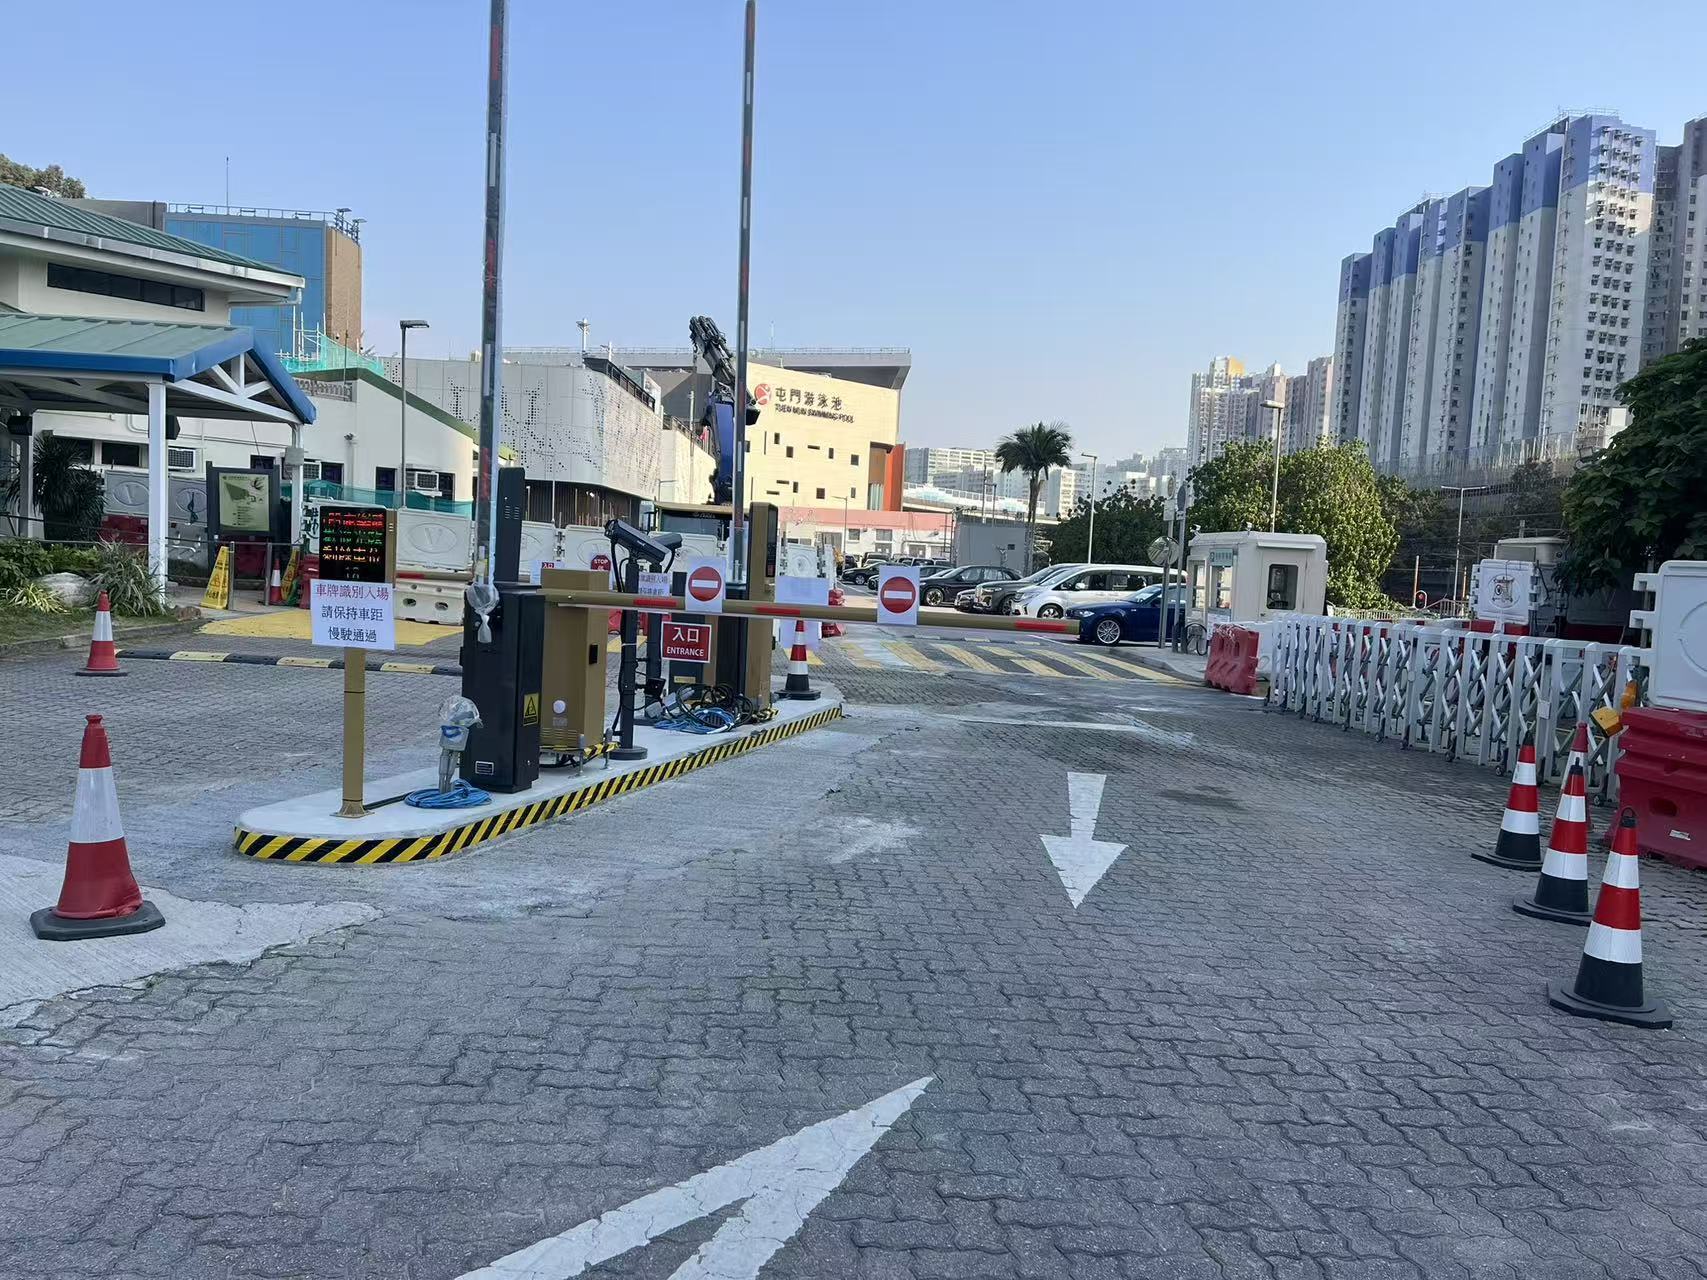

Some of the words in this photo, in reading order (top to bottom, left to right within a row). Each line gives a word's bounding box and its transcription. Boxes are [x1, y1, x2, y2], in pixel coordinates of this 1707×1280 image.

[775, 404, 791, 413] TUEN
[807, 409, 838, 420] SWIMMING
[838, 414, 854, 423] POOL
[316, 584, 389, 600] 車牌識別入場
[321, 605, 383, 621] 請保持車距
[328, 626, 377, 642] 慢駛通過
[672, 627, 699, 643] 入口
[666, 646, 704, 656] ENTRANCE
